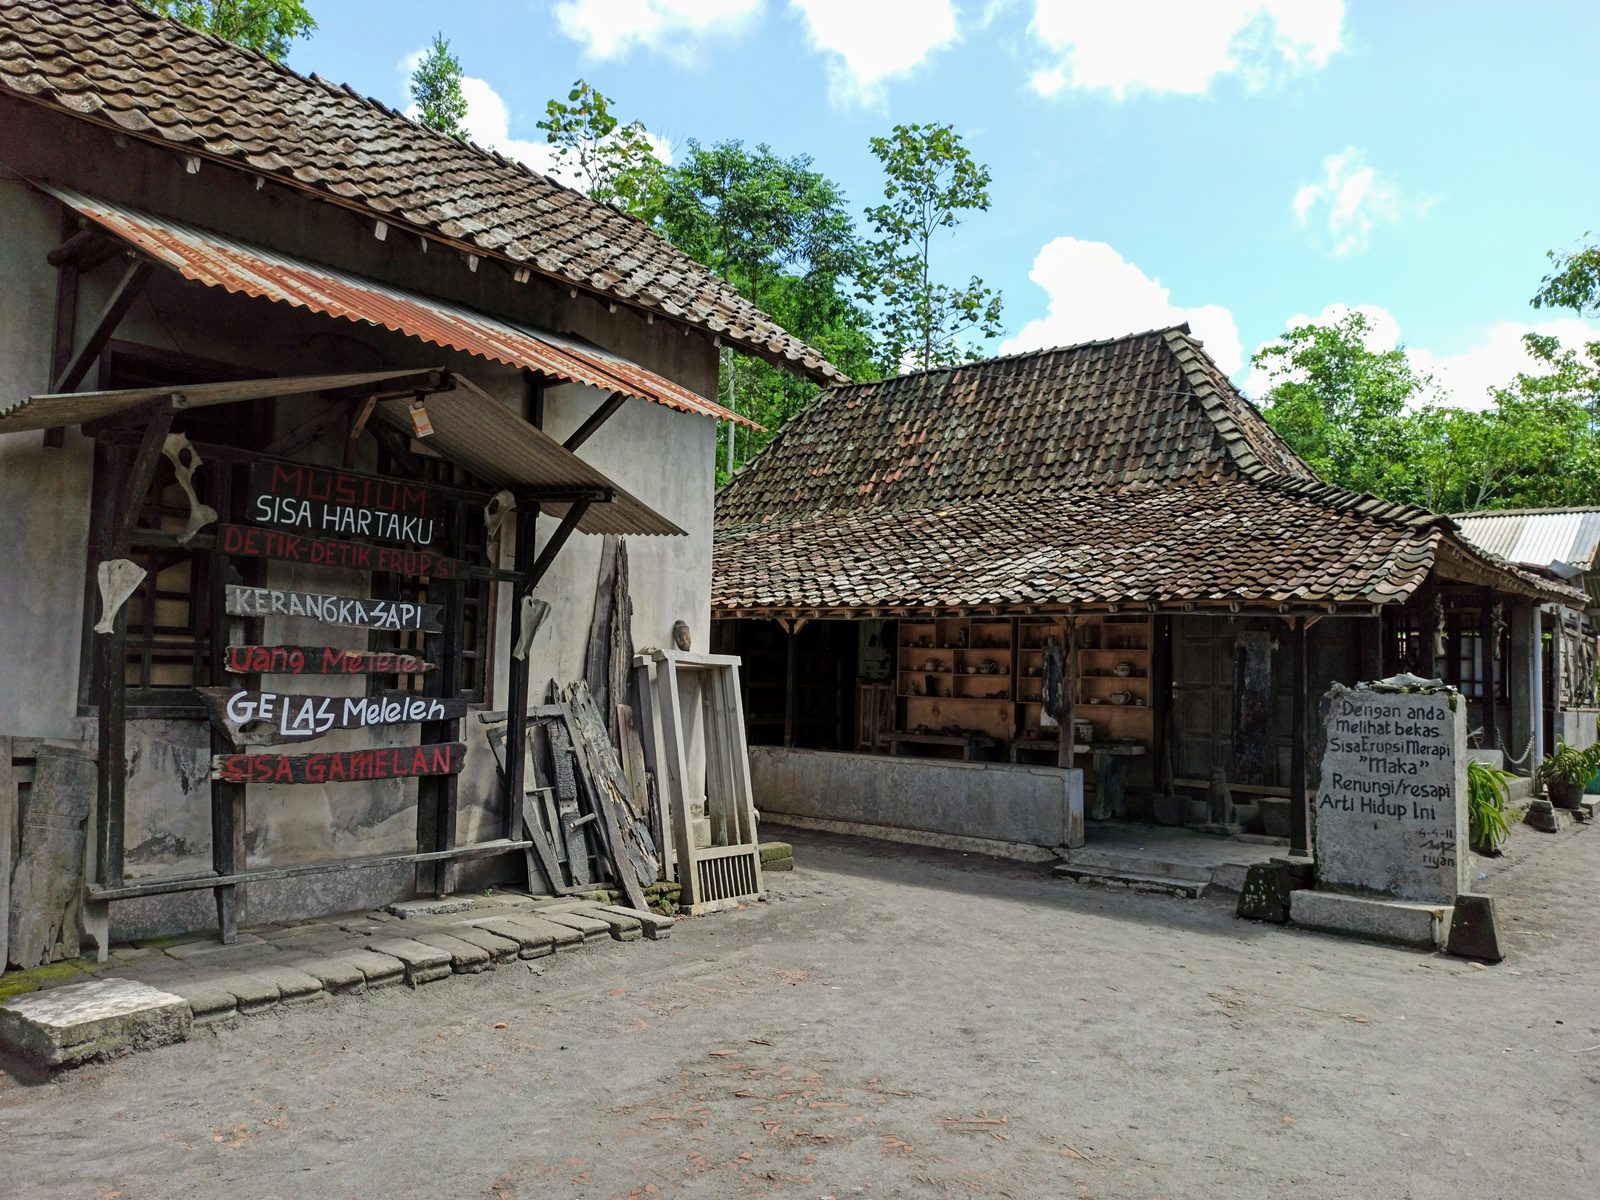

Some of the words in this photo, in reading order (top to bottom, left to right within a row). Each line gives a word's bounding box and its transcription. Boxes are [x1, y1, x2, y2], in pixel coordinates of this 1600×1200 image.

[271, 465, 428, 515] MUSIUM
[255, 494, 312, 528] SISA
[322, 504, 433, 545] HARTAKU
[224, 527, 370, 567] DETIK-DETIK
[235, 588, 369, 624] KERANGKA
[370, 601, 422, 629] SAPI
[1343, 701, 1401, 719] Dengan
[1407, 706, 1445, 720] anda
[219, 755, 295, 783] SISA
[305, 746, 451, 783] GAMELAN
[1360, 796, 1407, 821] Hidup
[1413, 802, 1436, 820] Ini
